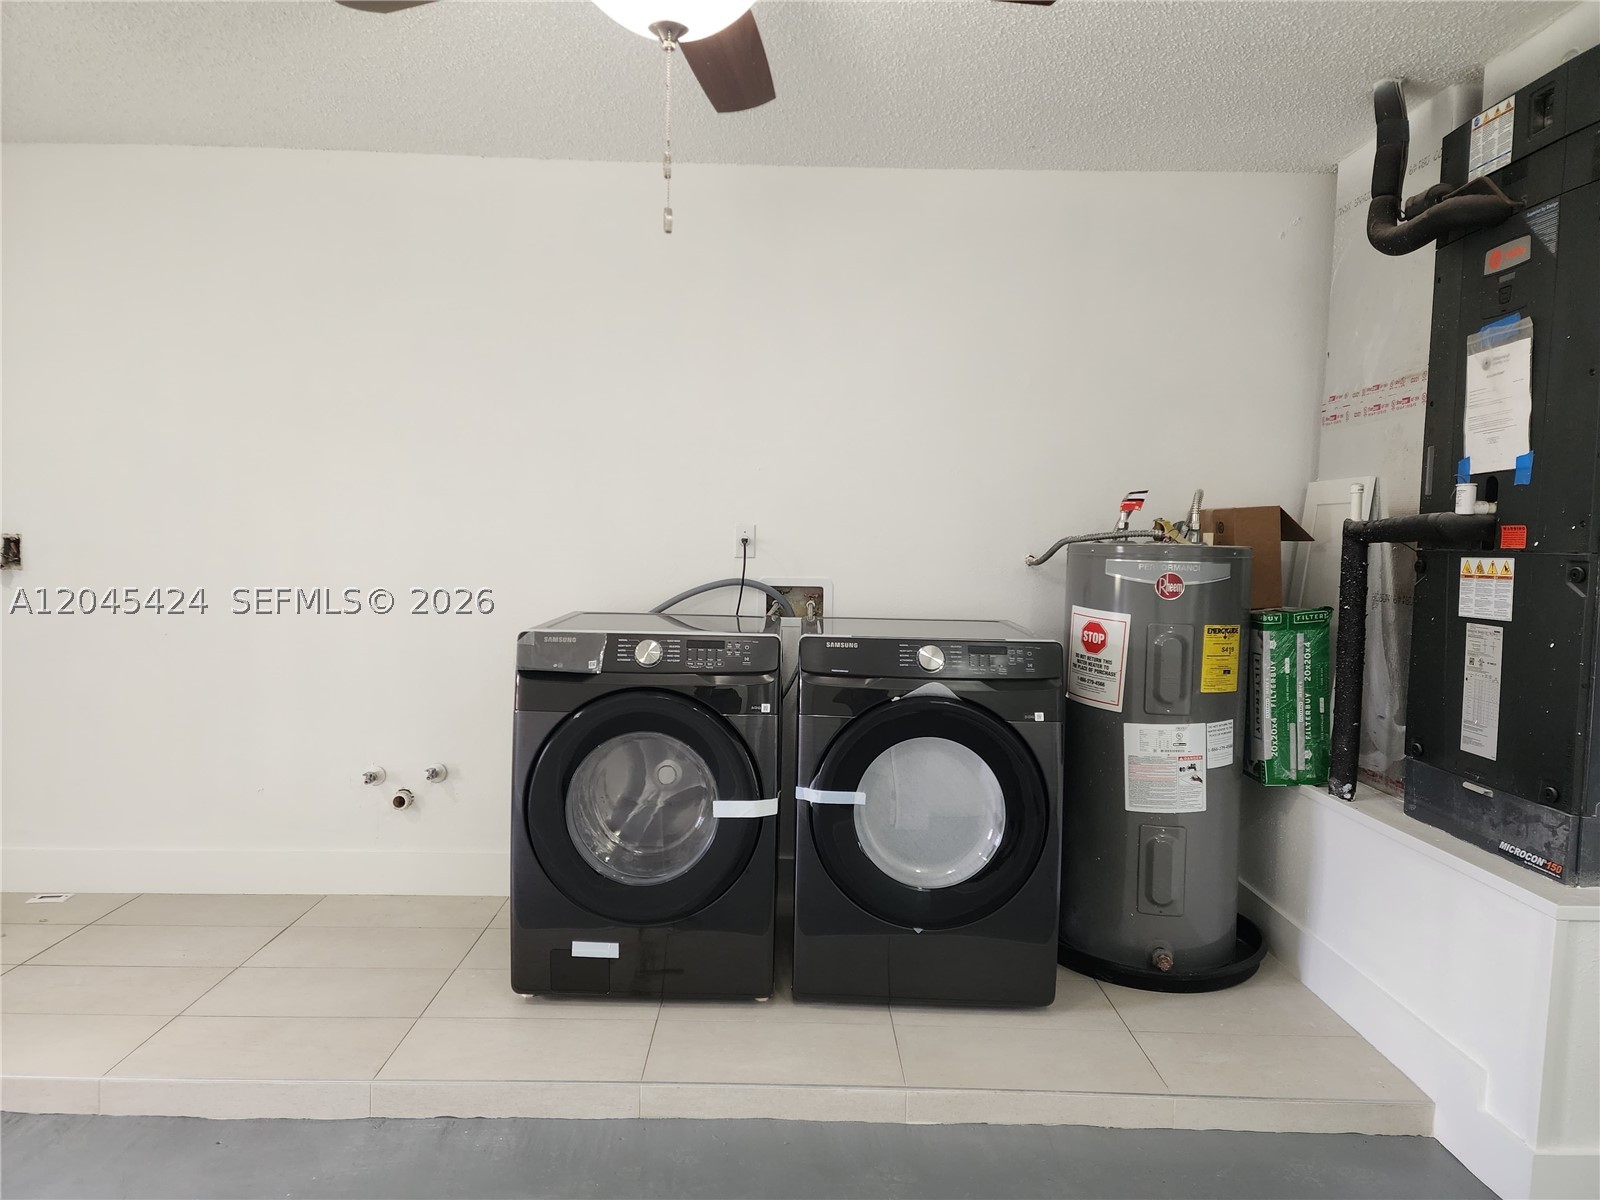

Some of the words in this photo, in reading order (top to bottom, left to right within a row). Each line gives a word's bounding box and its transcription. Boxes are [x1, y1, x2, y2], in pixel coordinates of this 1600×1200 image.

[1159, 573, 1183, 596] Rheem
[1083, 630, 1105, 645] STOP
[1088, 661, 1102, 669] HEATER
[1094, 668, 1116, 677] PURCHASE
[1304, 641, 1312, 682] 20x20x4
[1270, 660, 1278, 708] FILTERBUY
[1304, 692, 1312, 740] FILTERBUY
[1270, 717, 1278, 757] 20x20x4
[1547, 861, 1563, 874] 150
